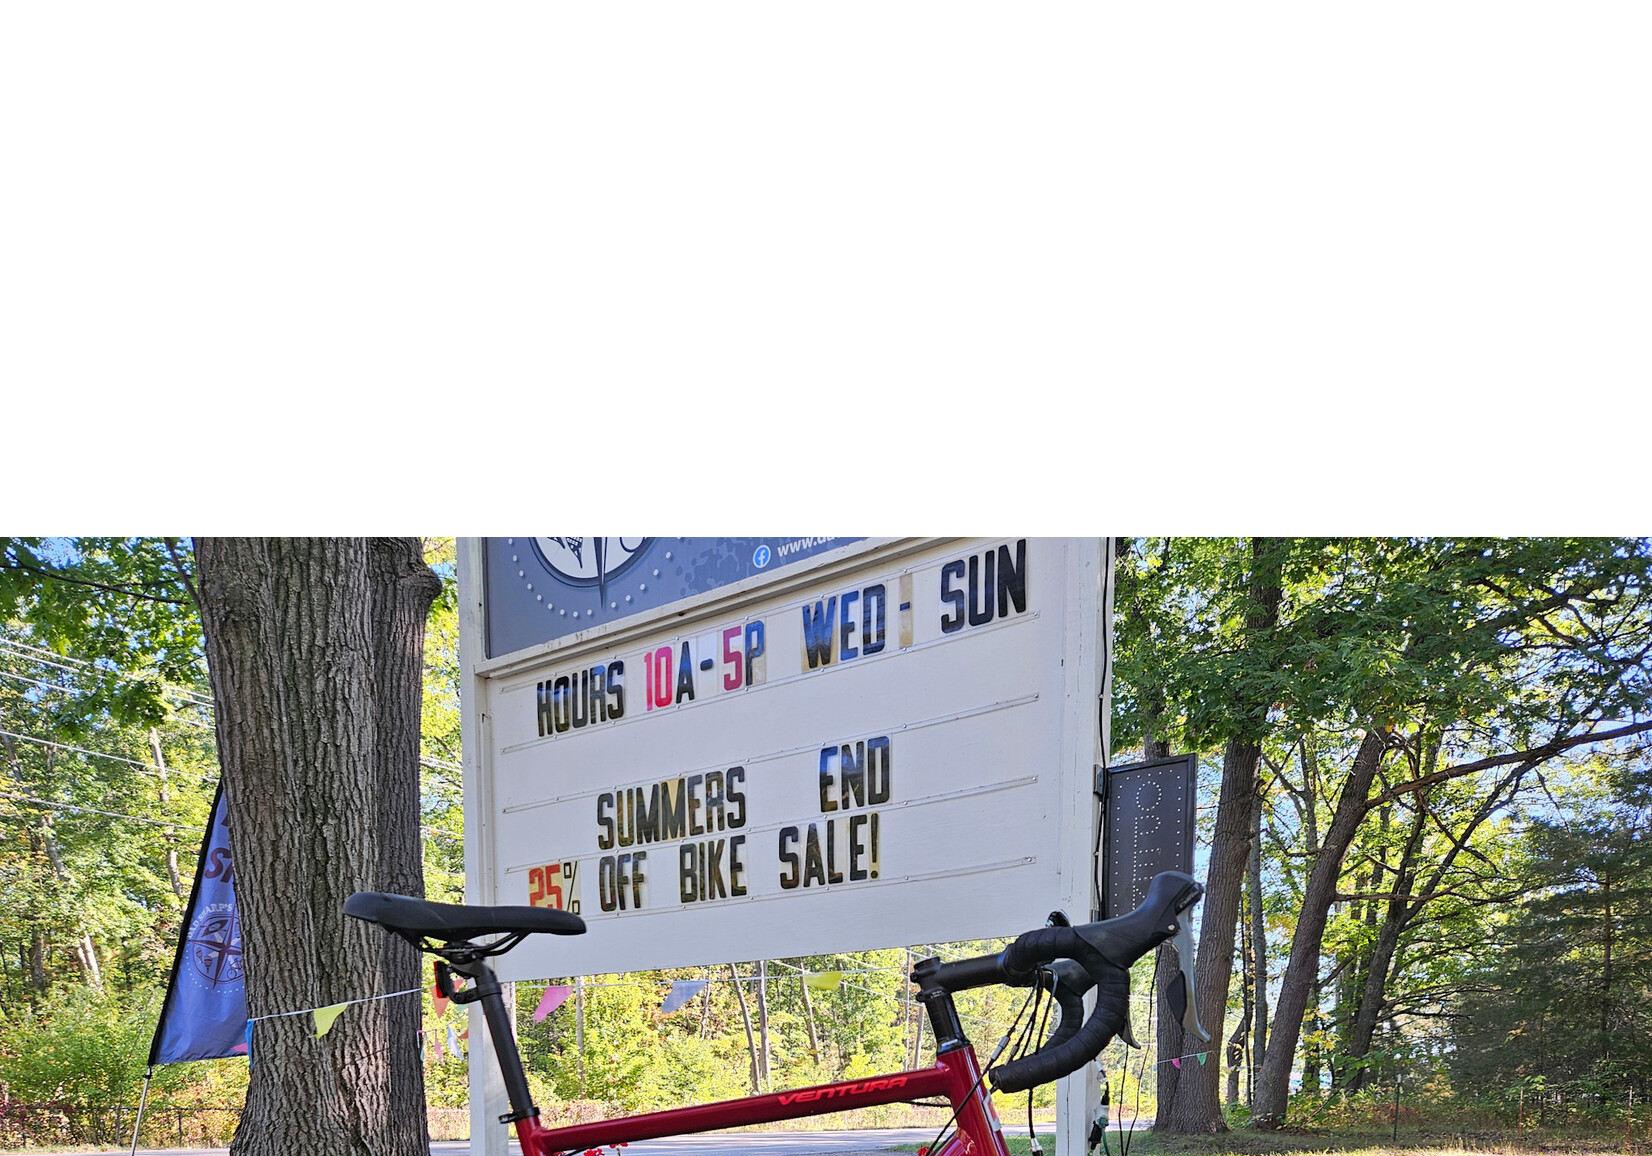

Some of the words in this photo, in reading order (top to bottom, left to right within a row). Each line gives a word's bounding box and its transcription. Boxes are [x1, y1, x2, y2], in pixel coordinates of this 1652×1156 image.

[537, 660, 625, 737] HOURS
[802, 584, 886, 668] WED
[941, 539, 1026, 633] SUN
[597, 766, 746, 850] SUMMERS
[819, 736, 890, 812] END
[528, 861, 580, 915] 25%
[600, 851, 646, 912] OFF
[679, 835, 747, 903] BIKE
[779, 813, 879, 889] SALE!
[778, 1077, 907, 1105] VENTURA
